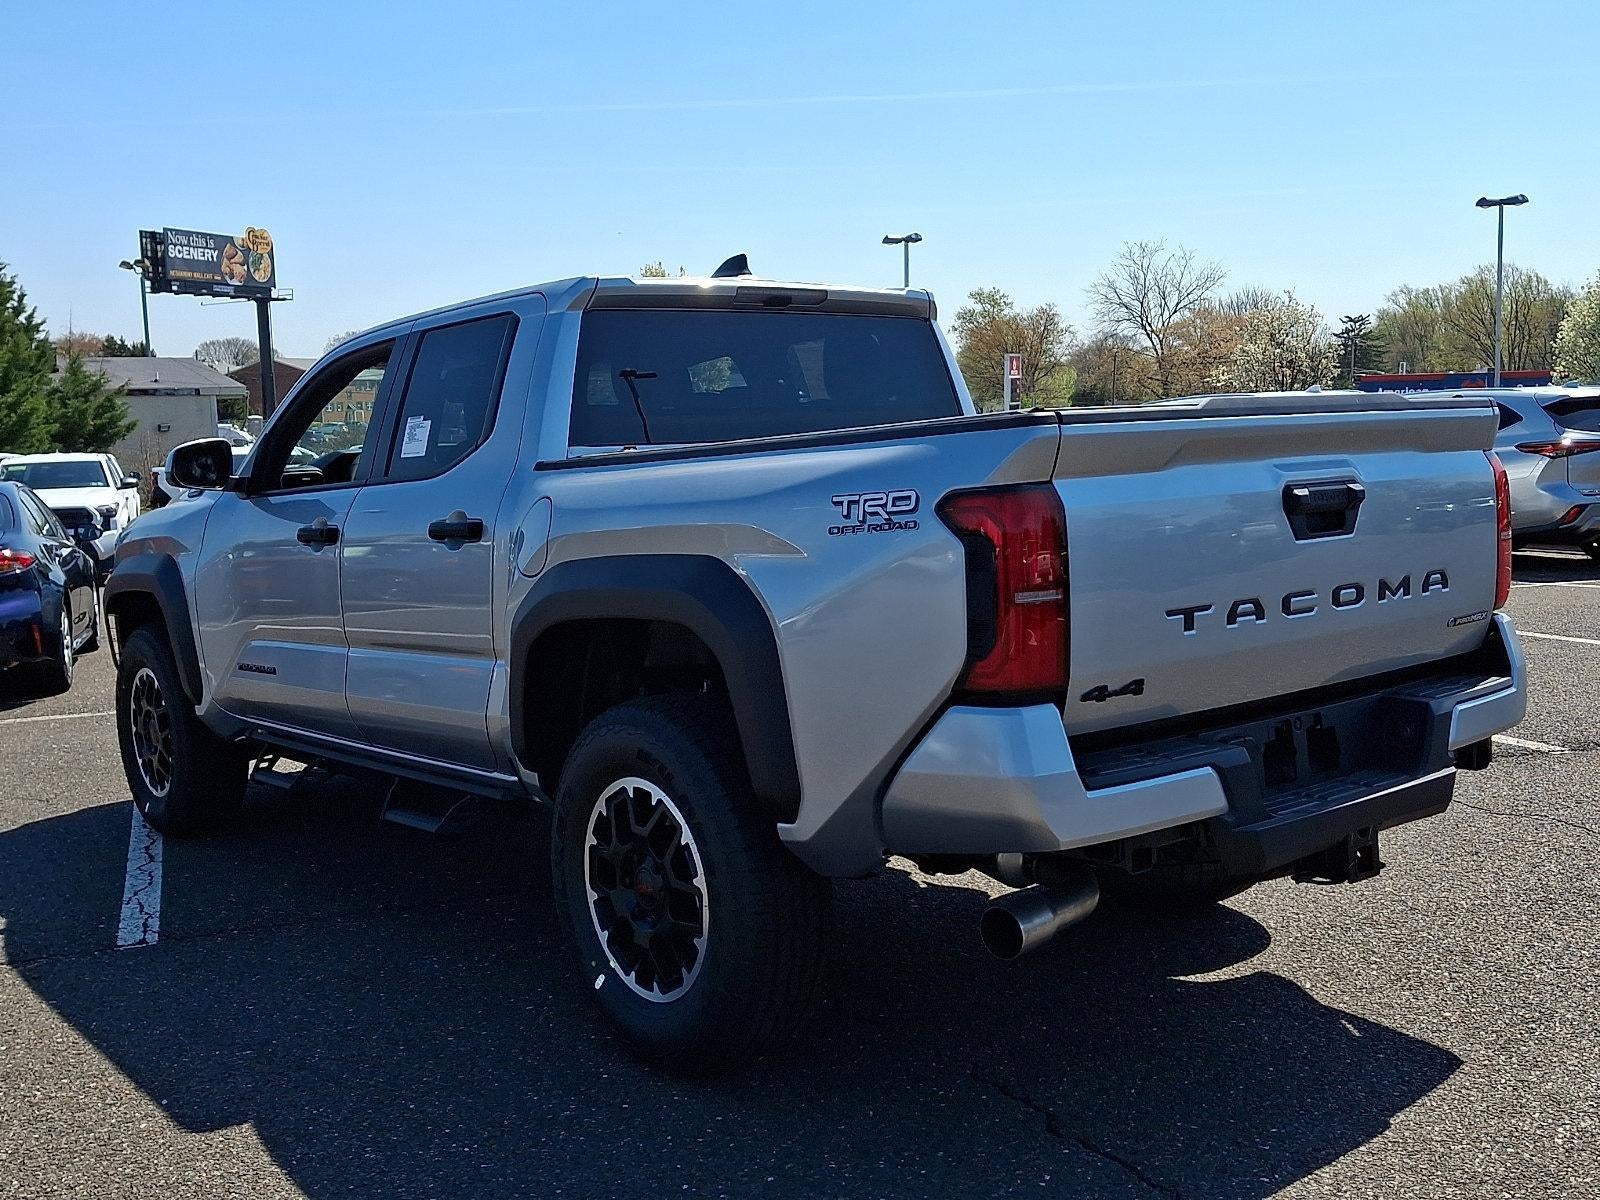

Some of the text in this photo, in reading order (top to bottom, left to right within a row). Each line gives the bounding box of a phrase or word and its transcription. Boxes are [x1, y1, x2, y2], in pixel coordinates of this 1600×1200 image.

[167, 230, 215, 248] Now this is
[168, 244, 219, 262] SCENERY
[830, 488, 920, 524] TRD
[827, 519, 920, 536] OFF ROAD
[1164, 568, 1450, 636] TACOMA
